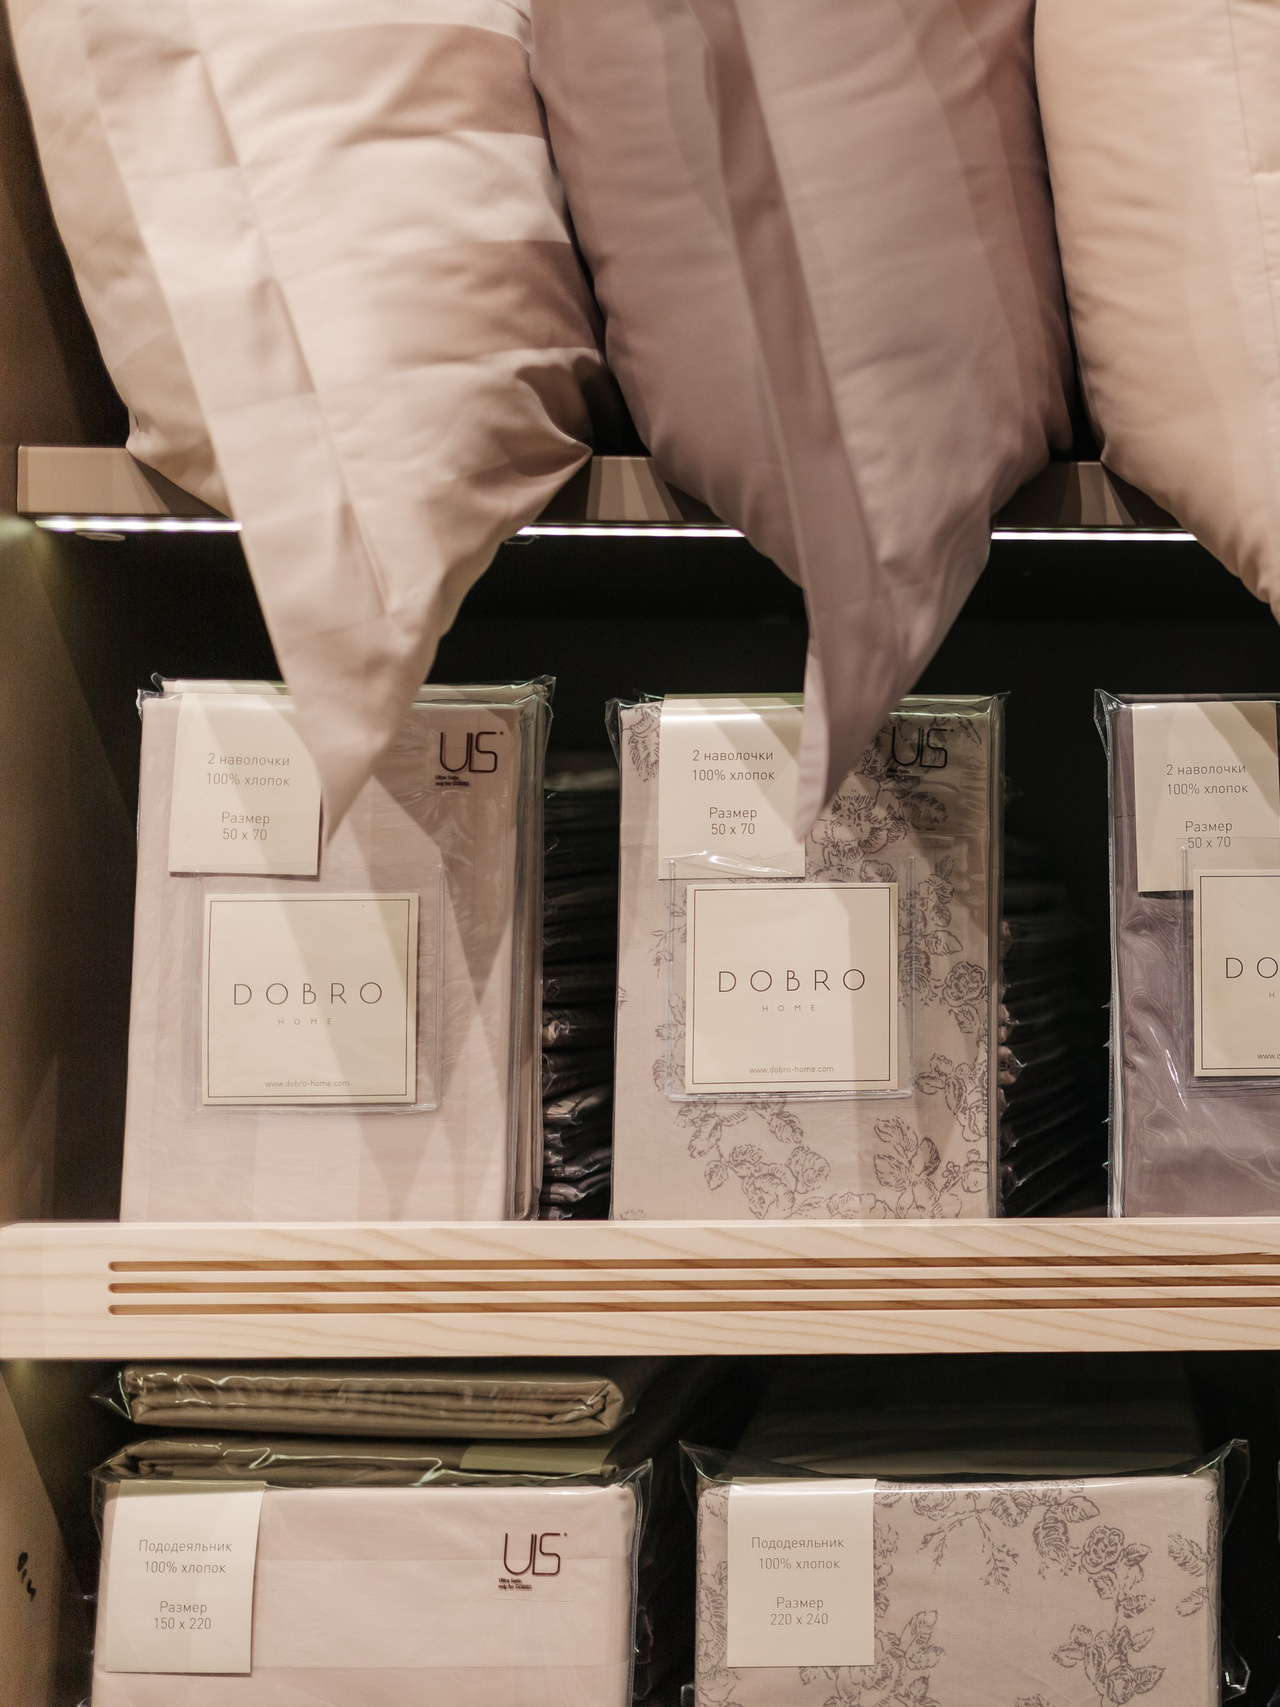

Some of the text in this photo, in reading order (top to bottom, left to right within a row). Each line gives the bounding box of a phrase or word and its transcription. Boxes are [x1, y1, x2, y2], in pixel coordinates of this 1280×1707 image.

[208, 753, 290, 766] 2 наволочки
[692, 750, 773, 762] 2 наволочки
[692, 769, 775, 782] 100% хлопок
[1166, 763, 1246, 776] 2 наволочки
[206, 773, 290, 786] 100% хлопок
[1166, 783, 1249, 795] 100% хлопок
[221, 812, 270, 826] Размер
[709, 807, 757, 821] Размер
[711, 823, 726, 835] 50
[741, 823, 755, 835] 70
[1185, 820, 1233, 833] Размер
[223, 828, 238, 841] 50
[252, 829, 267, 841] 70
[1187, 837, 1202, 849] 50
[1217, 836, 1231, 848] 70
[719, 969, 866, 993] DOBRO
[233, 982, 382, 1005] DOBRO
[762, 1004, 816, 1012] HOME
[278, 1017, 332, 1025] HOME
[749, 1065, 834, 1074] www.dobro-home.com
[265, 1079, 350, 1089] www.dobro-home.com
[138, 1540, 232, 1554] Пододеяльник
[751, 1536, 844, 1550] Пододеяльник
[144, 1561, 226, 1574] 100% хлопок
[758, 1557, 840, 1570] 100% хлопок
[159, 1601, 207, 1615] Размер
[776, 1597, 824, 1612] Размер
[154, 1617, 174, 1630] 150
[189, 1617, 212, 1630] 220
[770, 1613, 793, 1626] 220
[806, 1613, 829, 1626] 240
